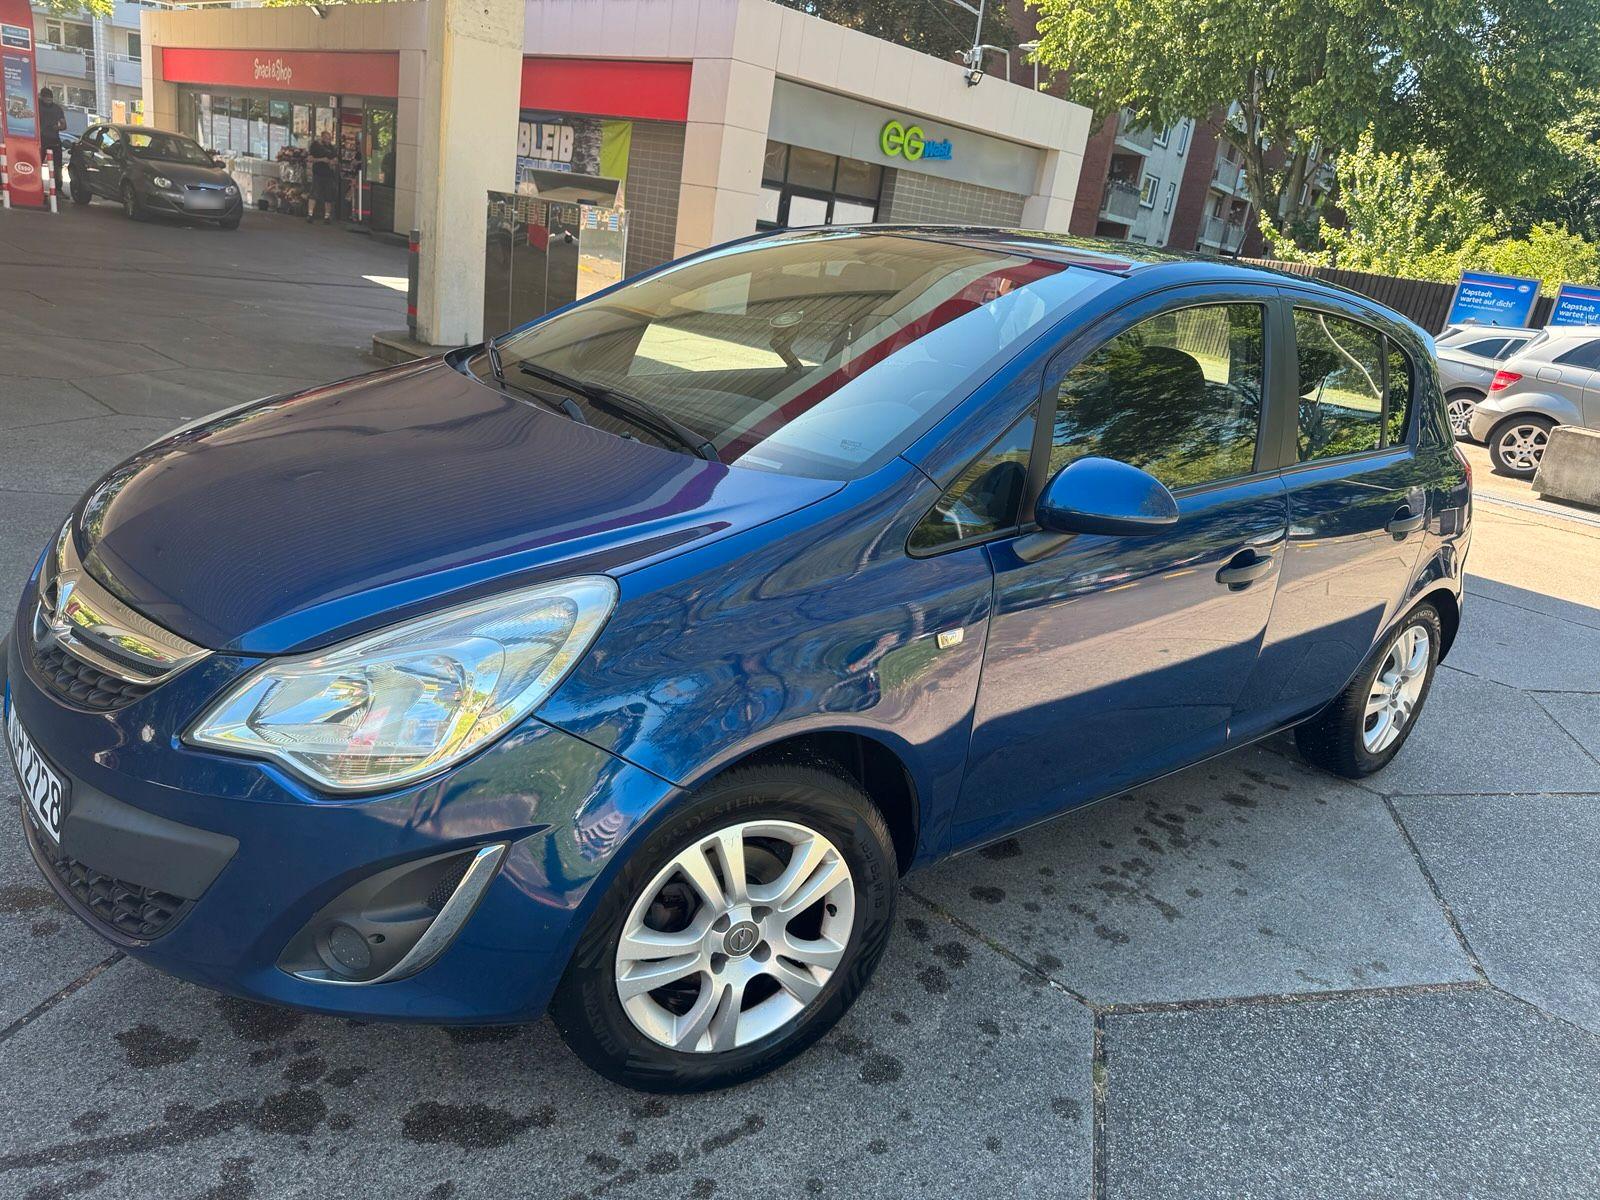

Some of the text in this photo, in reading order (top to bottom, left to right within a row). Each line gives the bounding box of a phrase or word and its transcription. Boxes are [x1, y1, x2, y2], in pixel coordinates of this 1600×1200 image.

[517, 121, 575, 162] BLEIB
[1462, 288, 1492, 298] Kapstadt
[1460, 296, 1483, 304] wartet
[1561, 302, 1595, 312] Kapstadt
[1559, 310, 1585, 319] wartet
